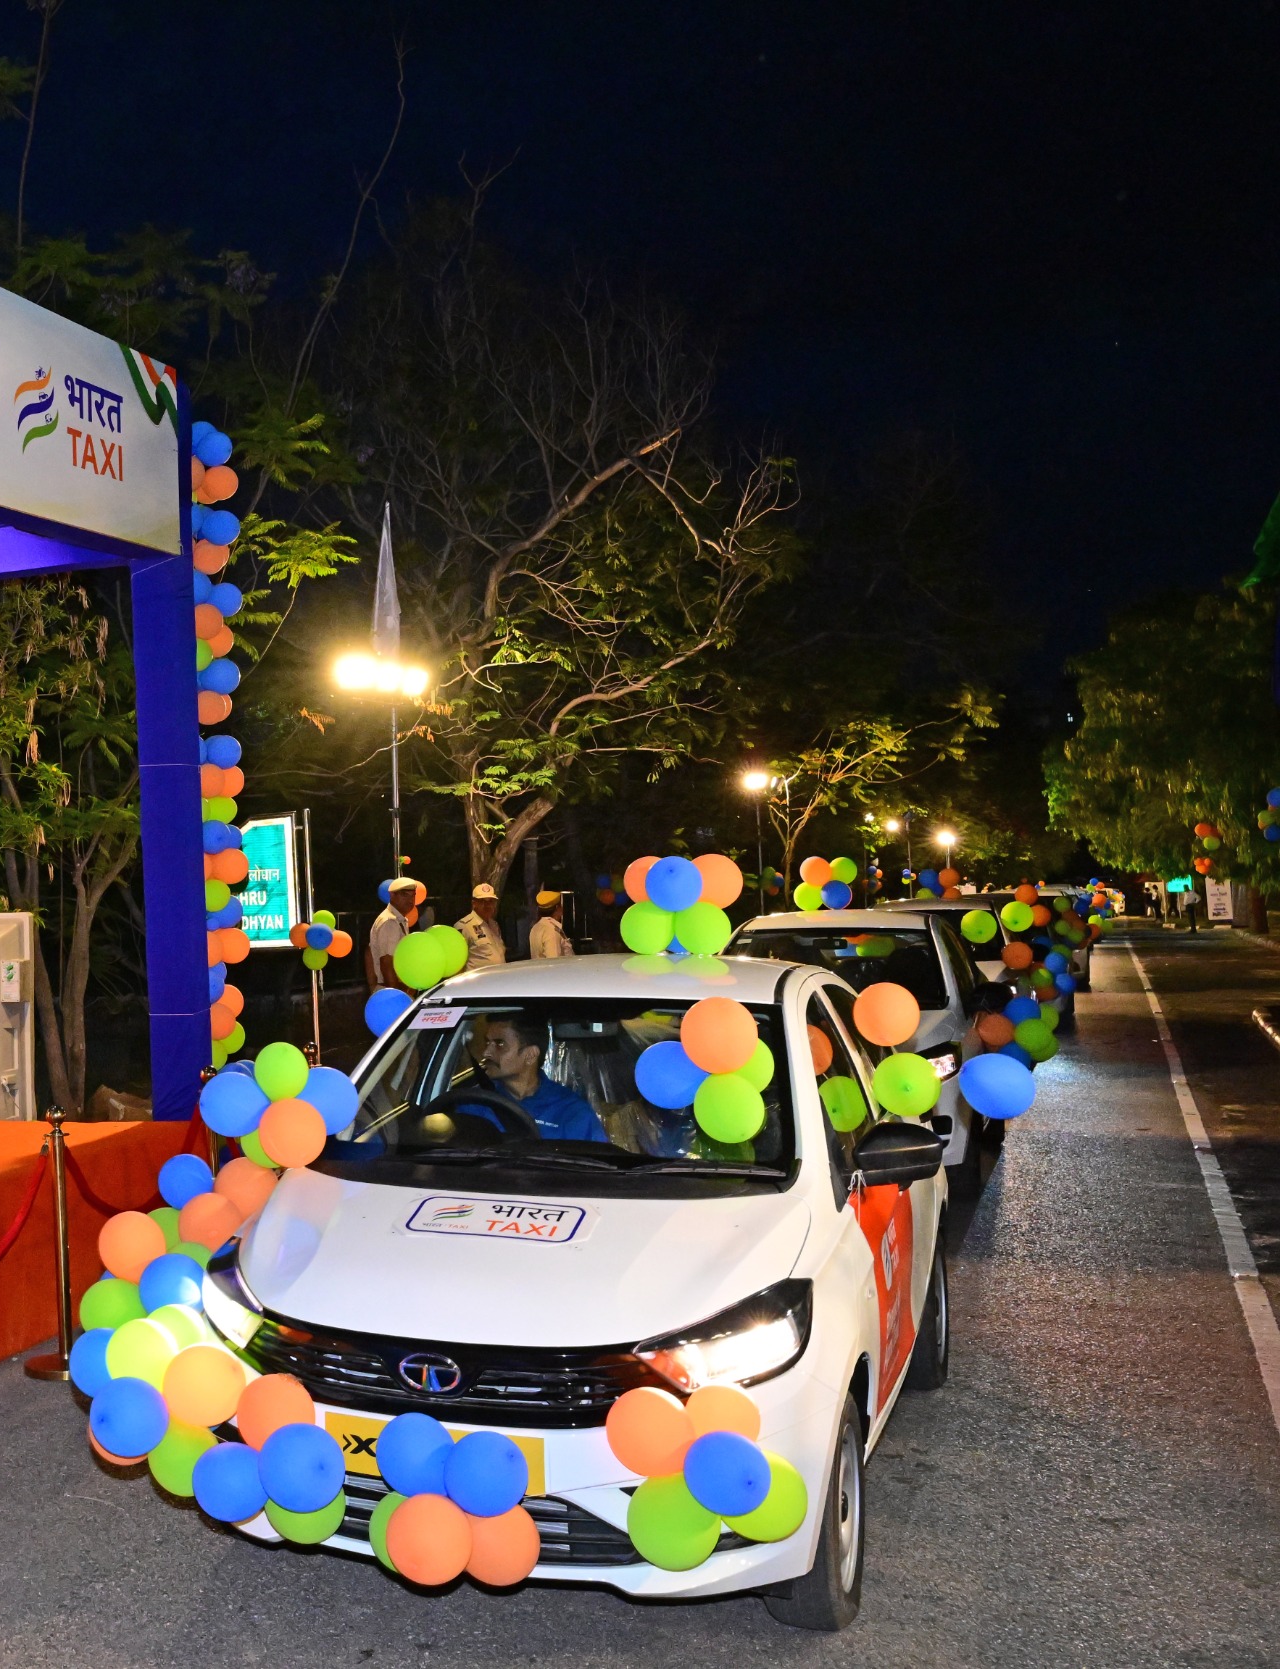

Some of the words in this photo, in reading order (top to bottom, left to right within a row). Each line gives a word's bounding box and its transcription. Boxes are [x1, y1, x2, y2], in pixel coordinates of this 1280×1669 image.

[64, 374, 123, 433] भारत
[67, 427, 123, 481] TAXI
[238, 891, 267, 906] HRU
[241, 915, 283, 930] DHYAN
[492, 1204, 569, 1222] भारत
[486, 1219, 558, 1237] TAXI
